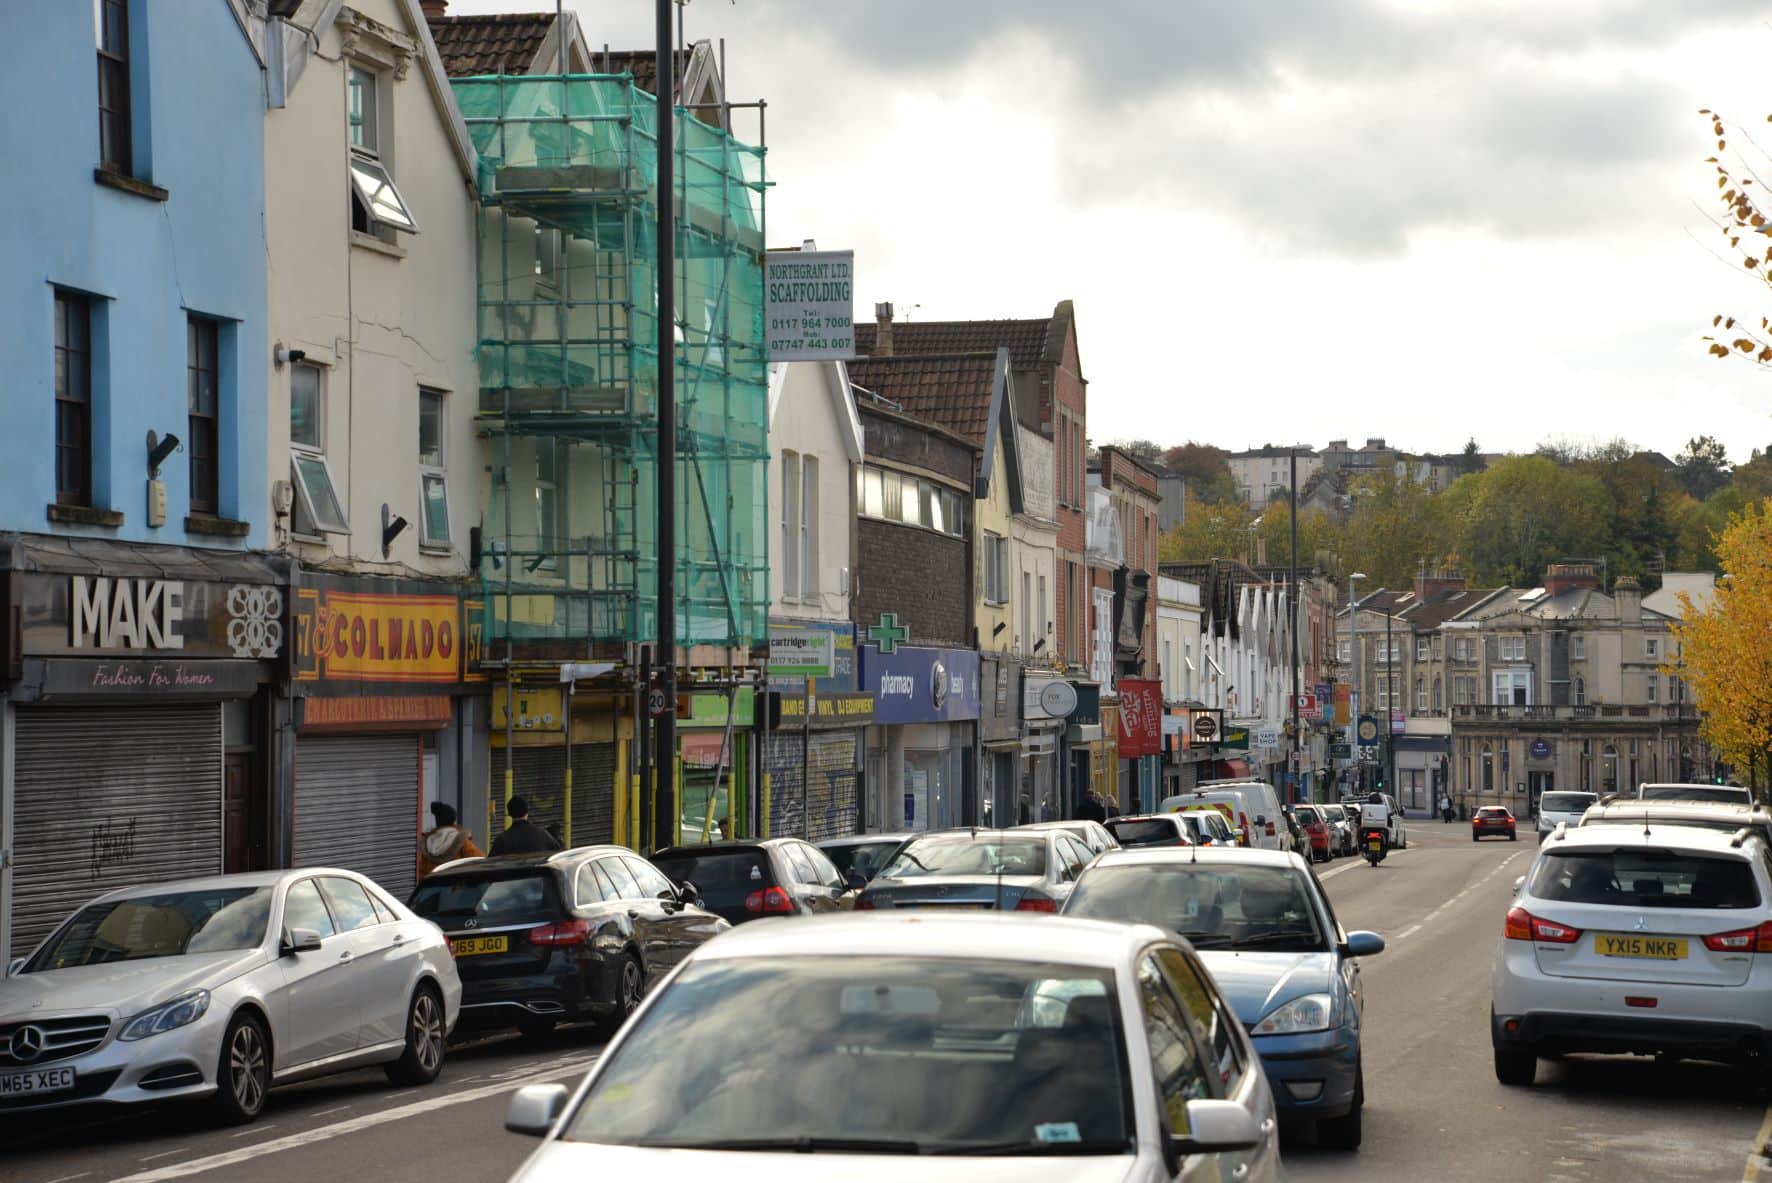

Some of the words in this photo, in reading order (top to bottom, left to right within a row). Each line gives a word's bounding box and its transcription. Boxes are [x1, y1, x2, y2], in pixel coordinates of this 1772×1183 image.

[769, 264, 828, 280] NORTHGRANT
[770, 281, 850, 303] SCAFFOLDING
[772, 319, 798, 329] 0117
[825, 317, 850, 328] 7000
[771, 340, 804, 350] 07747
[831, 338, 850, 348] 007
[72, 575, 184, 649] MAKE
[334, 613, 453, 660] COLMADO
[93, 664, 145, 685] Fashion
[149, 665, 171, 685] For
[175, 665, 215, 685] Women
[880, 670, 914, 699] pharmacy
[649, 695, 664, 707] 20
[1605, 937, 1640, 954] YX15
[1645, 939, 1677, 956] NKR
[0, 1074, 33, 1092] M65
[38, 1070, 70, 1088] XEC
